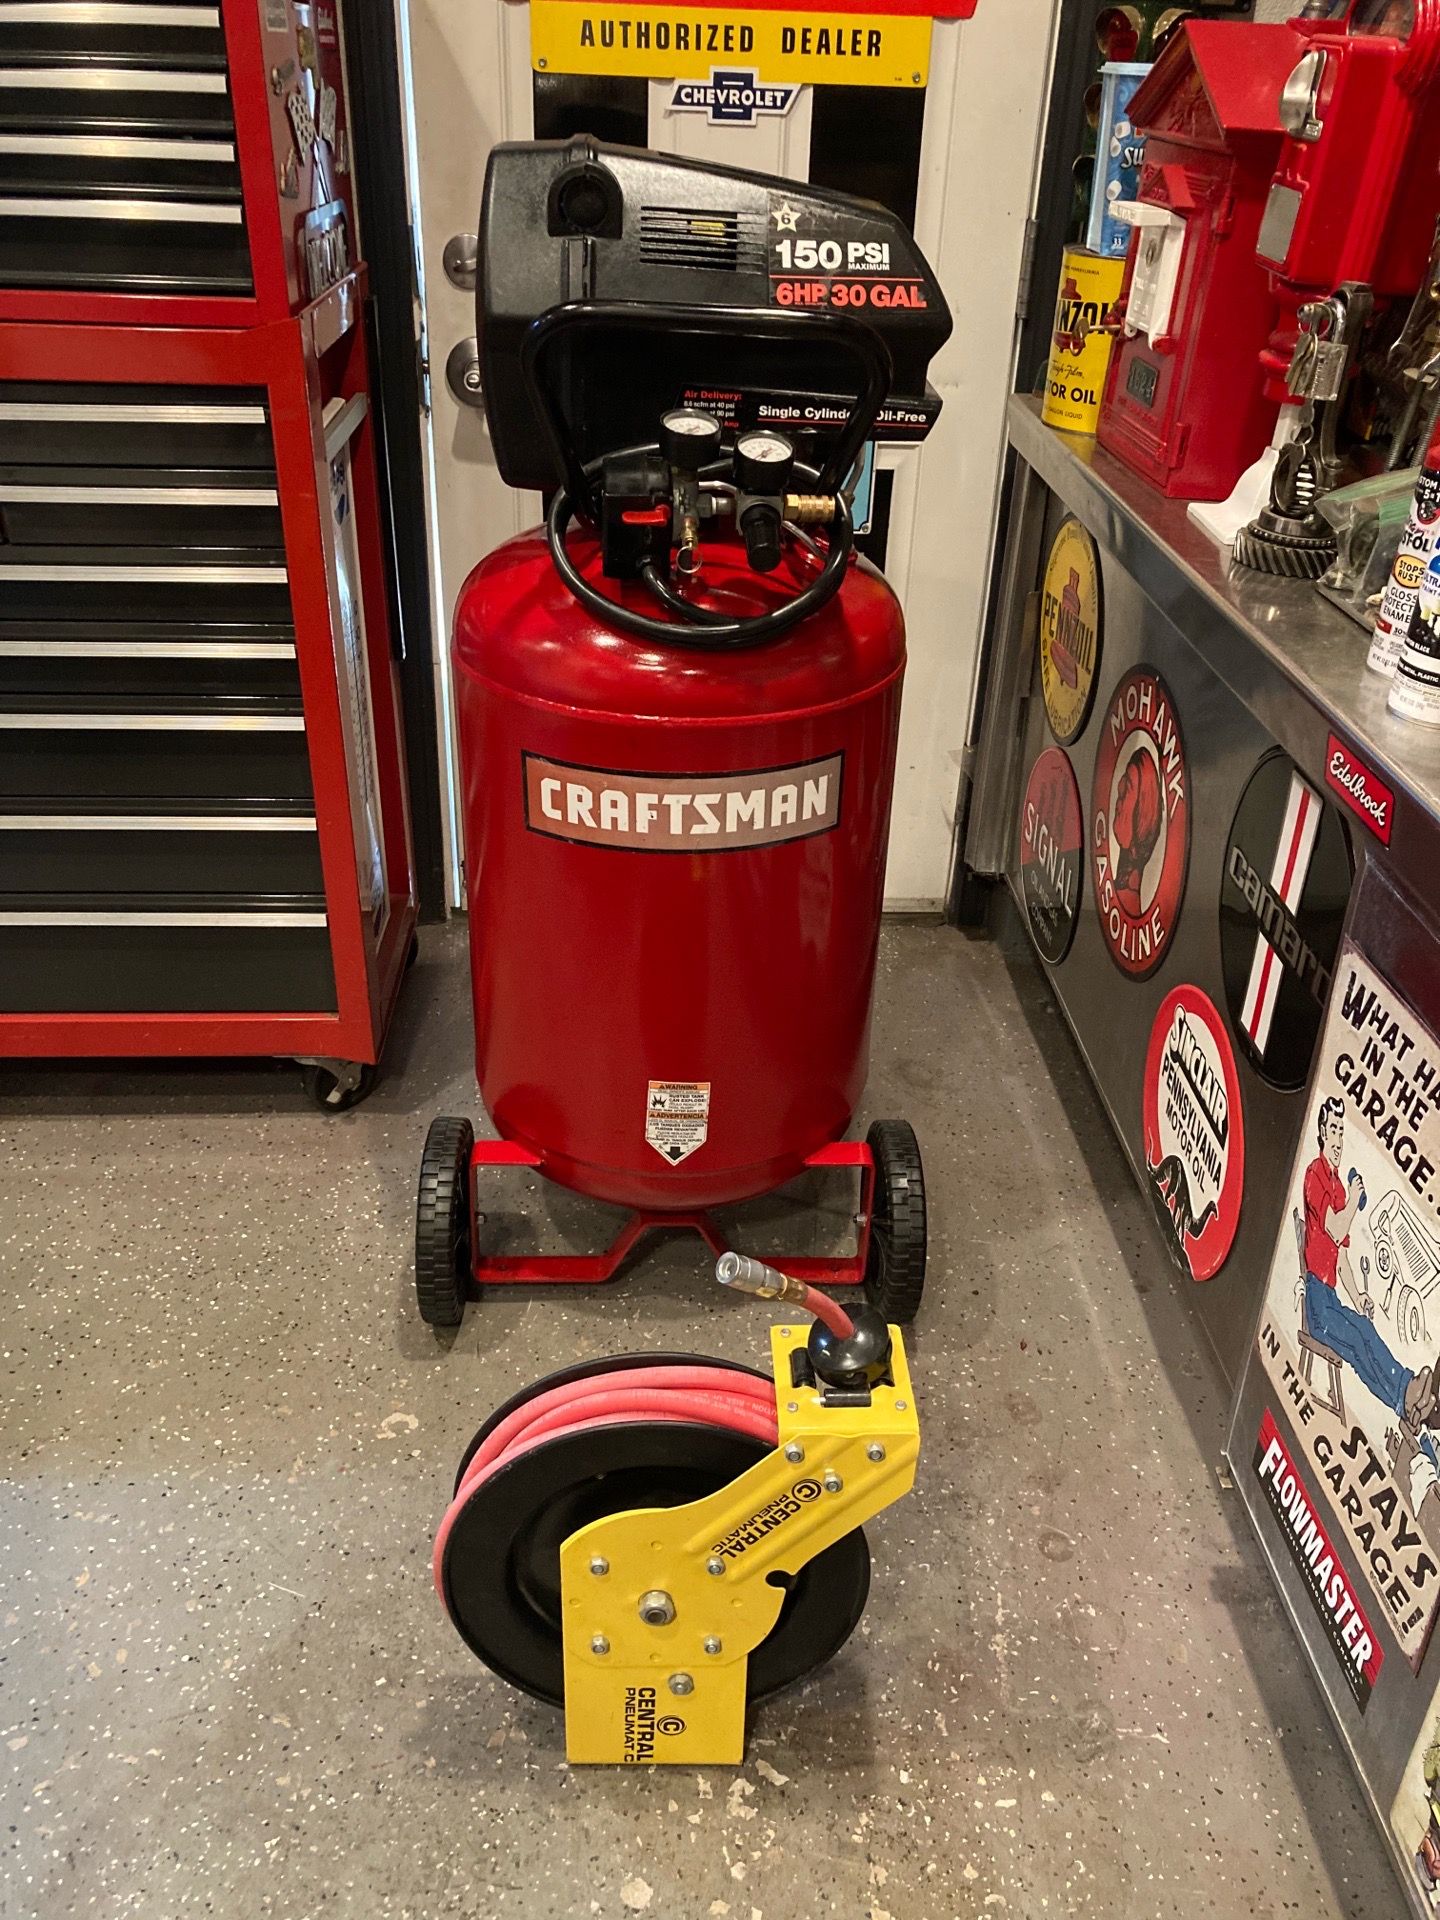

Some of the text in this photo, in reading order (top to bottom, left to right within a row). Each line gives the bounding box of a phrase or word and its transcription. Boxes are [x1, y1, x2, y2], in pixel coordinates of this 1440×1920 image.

[580, 19, 882, 57] AUTHORIZED DEALER
[680, 87, 785, 107] CHEVROLET
[775, 239, 890, 270] 150 PSI
[781, 213, 791, 225] 6
[776, 282, 927, 308] 6HP 30 GAL
[848, 263, 890, 271] MAXIMUM
[684, 390, 742, 400] Air Delivery:
[759, 405, 800, 419] Single
[1070, 388, 1096, 405] OIL
[1398, 570, 1419, 583] RUST
[1399, 560, 1425, 575] STOPS
[1110, 682, 1183, 819] MOHAWK
[541, 774, 829, 835] CRAFTSMAN
[1330, 752, 1386, 826] Edelbrock
[1025, 803, 1072, 918] SIGNAL
[1095, 810, 1165, 961] GASOLINE
[1341, 970, 1415, 1061] WHAT
[1169, 1005, 1228, 1136] SINCLAIR
[1360, 1037, 1429, 1132] IN THE
[1162, 1052, 1222, 1190] PENNSYLVANIA
[1165, 1098, 1205, 1193] MOTOR OIL
[1261, 1323, 1281, 1359] IN
[1282, 1360, 1315, 1426] THE
[711, 1494, 790, 1553] PNEUMATIC
[720, 1500, 801, 1558] CENTRAL
[1340, 1426, 1438, 1589] STAYS
[1258, 1436, 1373, 1674] FLOWMASTER
[1267, 1486, 1279, 1506] THE
[1299, 1555, 1333, 1627] TECHNOLOGY
[624, 1687, 636, 1762] PNEUMATC
[637, 1687, 656, 1761] CENTRAL
